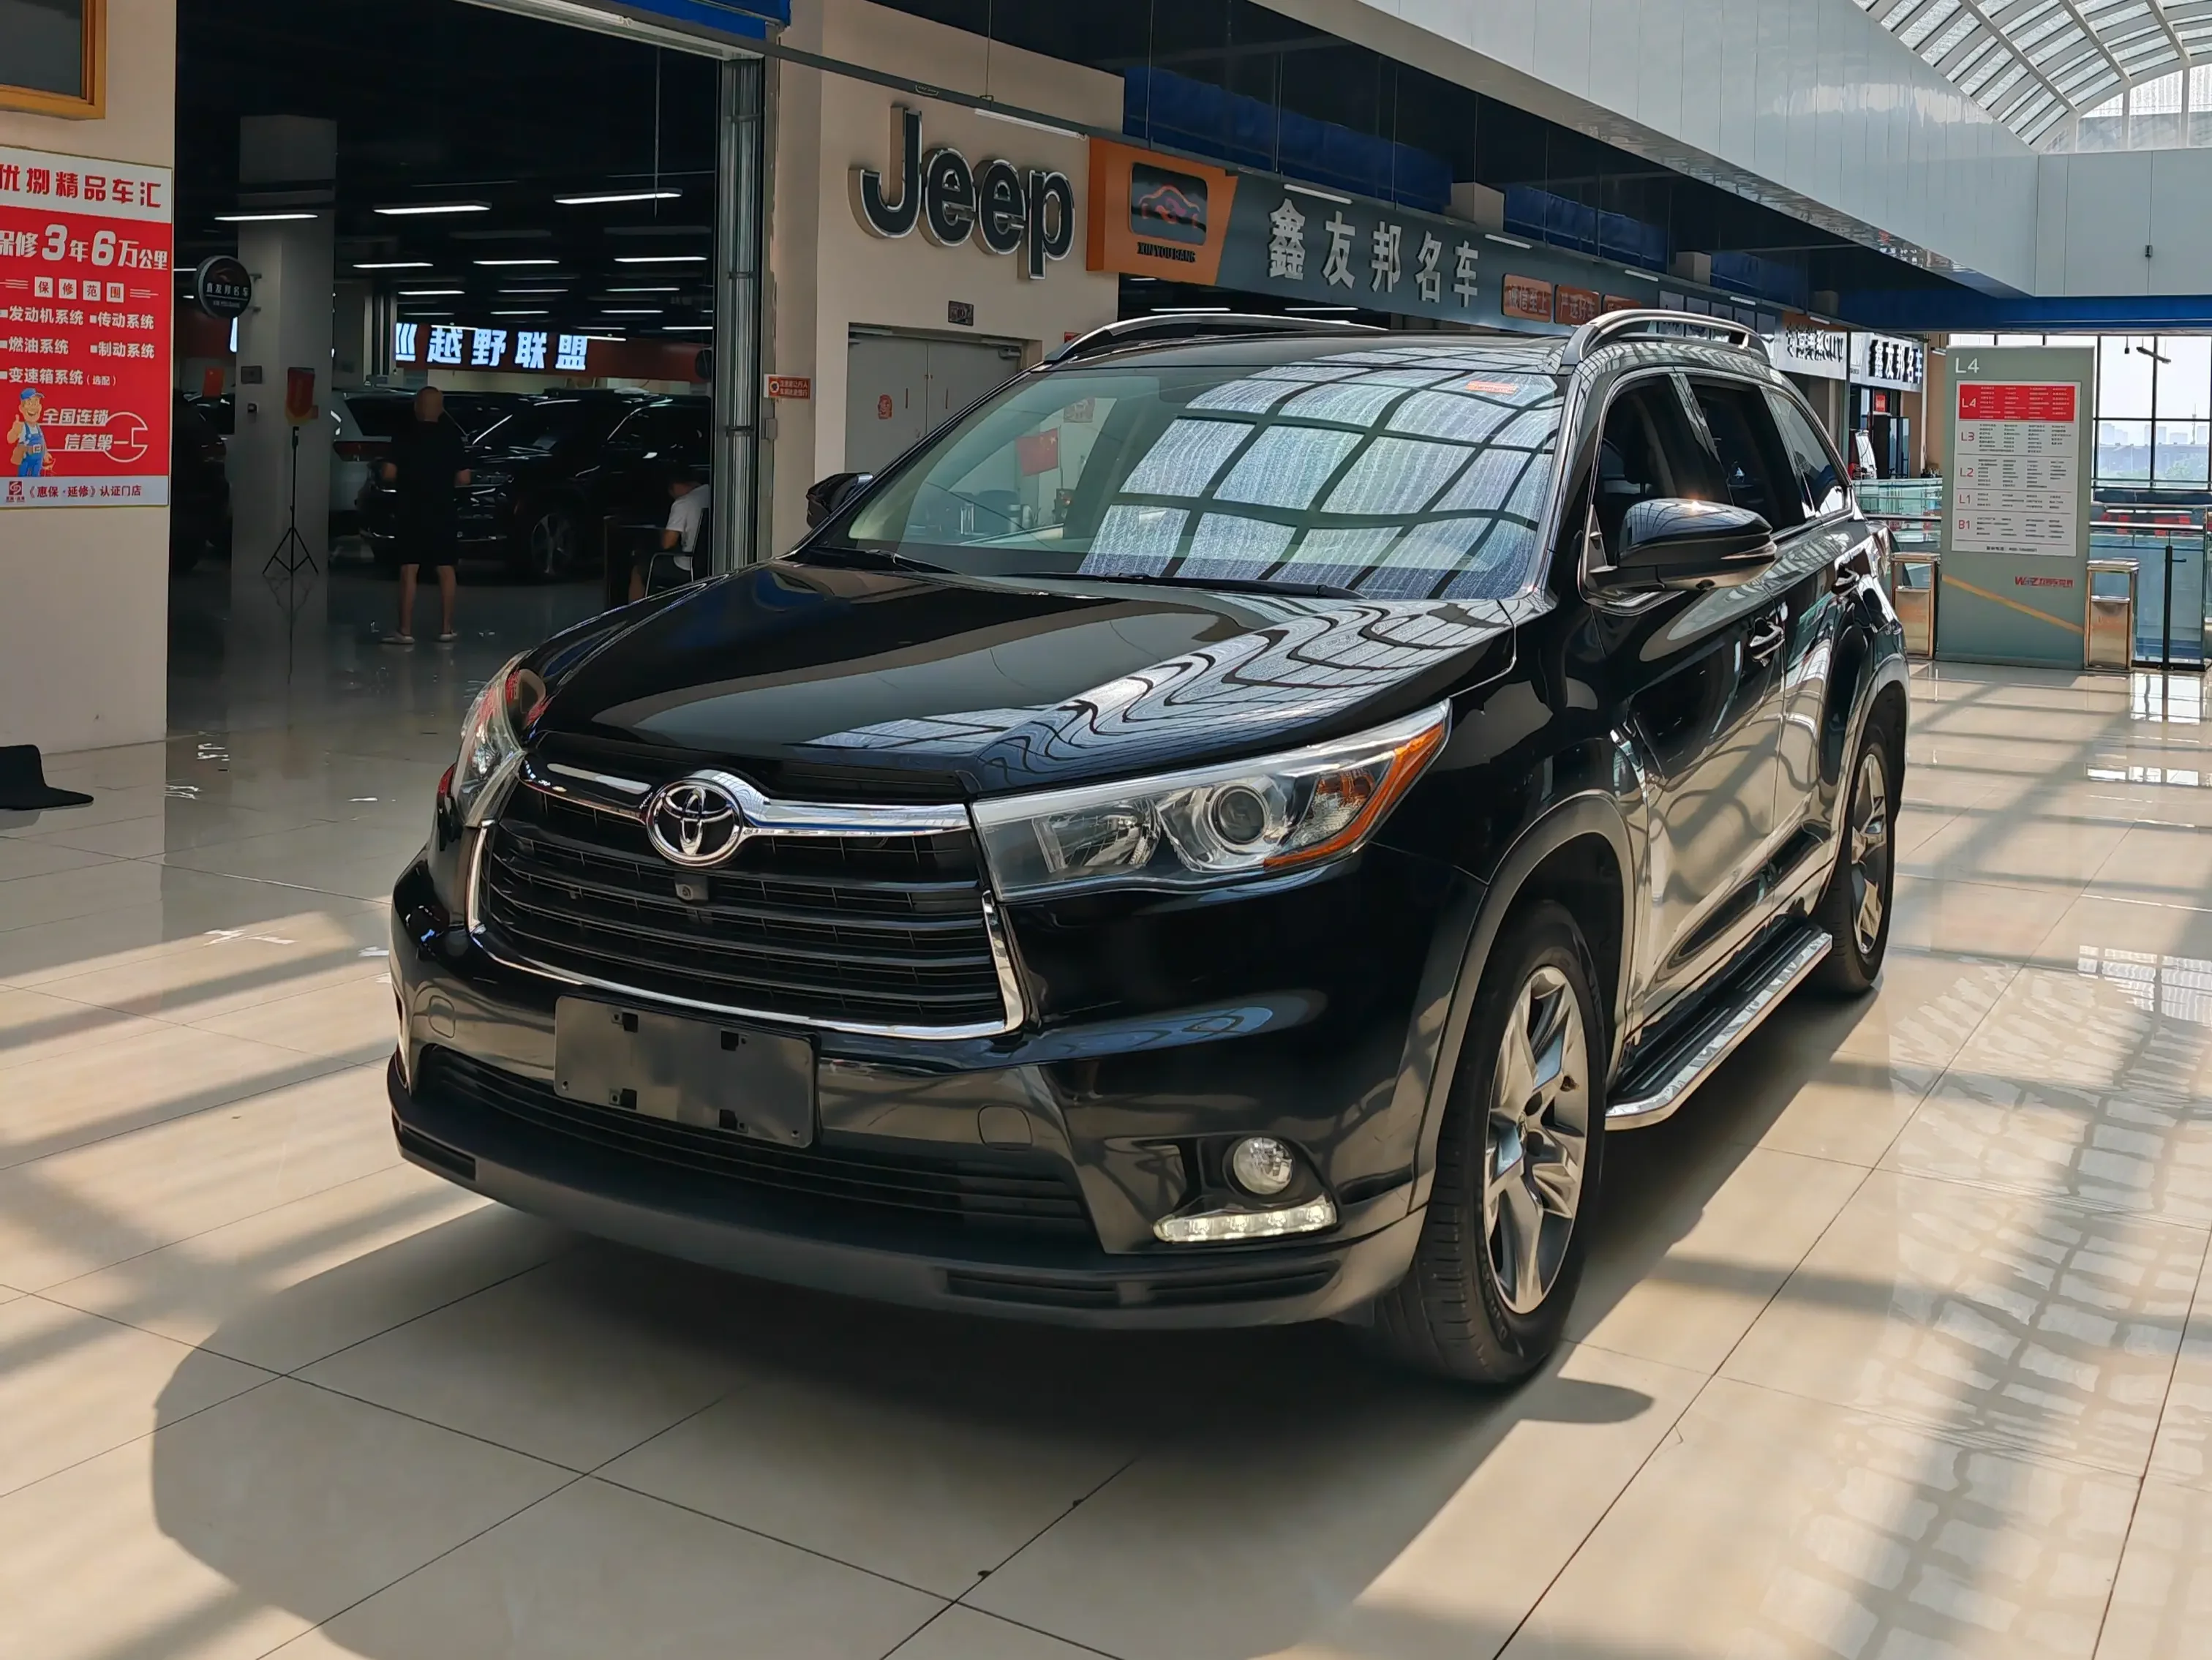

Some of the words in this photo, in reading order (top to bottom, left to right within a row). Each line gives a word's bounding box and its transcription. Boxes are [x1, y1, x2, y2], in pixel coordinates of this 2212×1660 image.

[0, 163, 162, 209] 优捌精品车汇
[850, 105, 1076, 279] Jeep
[0, 223, 168, 271] 保修3年6万公里
[1268, 198, 1479, 308] 鑫友邦名车
[9, 305, 84, 326] 发动机系统
[97, 312, 155, 330] 传动系统
[9, 336, 69, 355] 燃油系统
[98, 341, 155, 358] 制动系统
[1873, 340, 1923, 385] 鑫友邦名车
[1955, 357, 1979, 374] L4
[1961, 397, 1976, 408] L4
[1960, 432, 1975, 442] L3
[1960, 467, 1974, 478] L2
[1959, 494, 1971, 504] L1
[1957, 519, 1971, 530] B1
